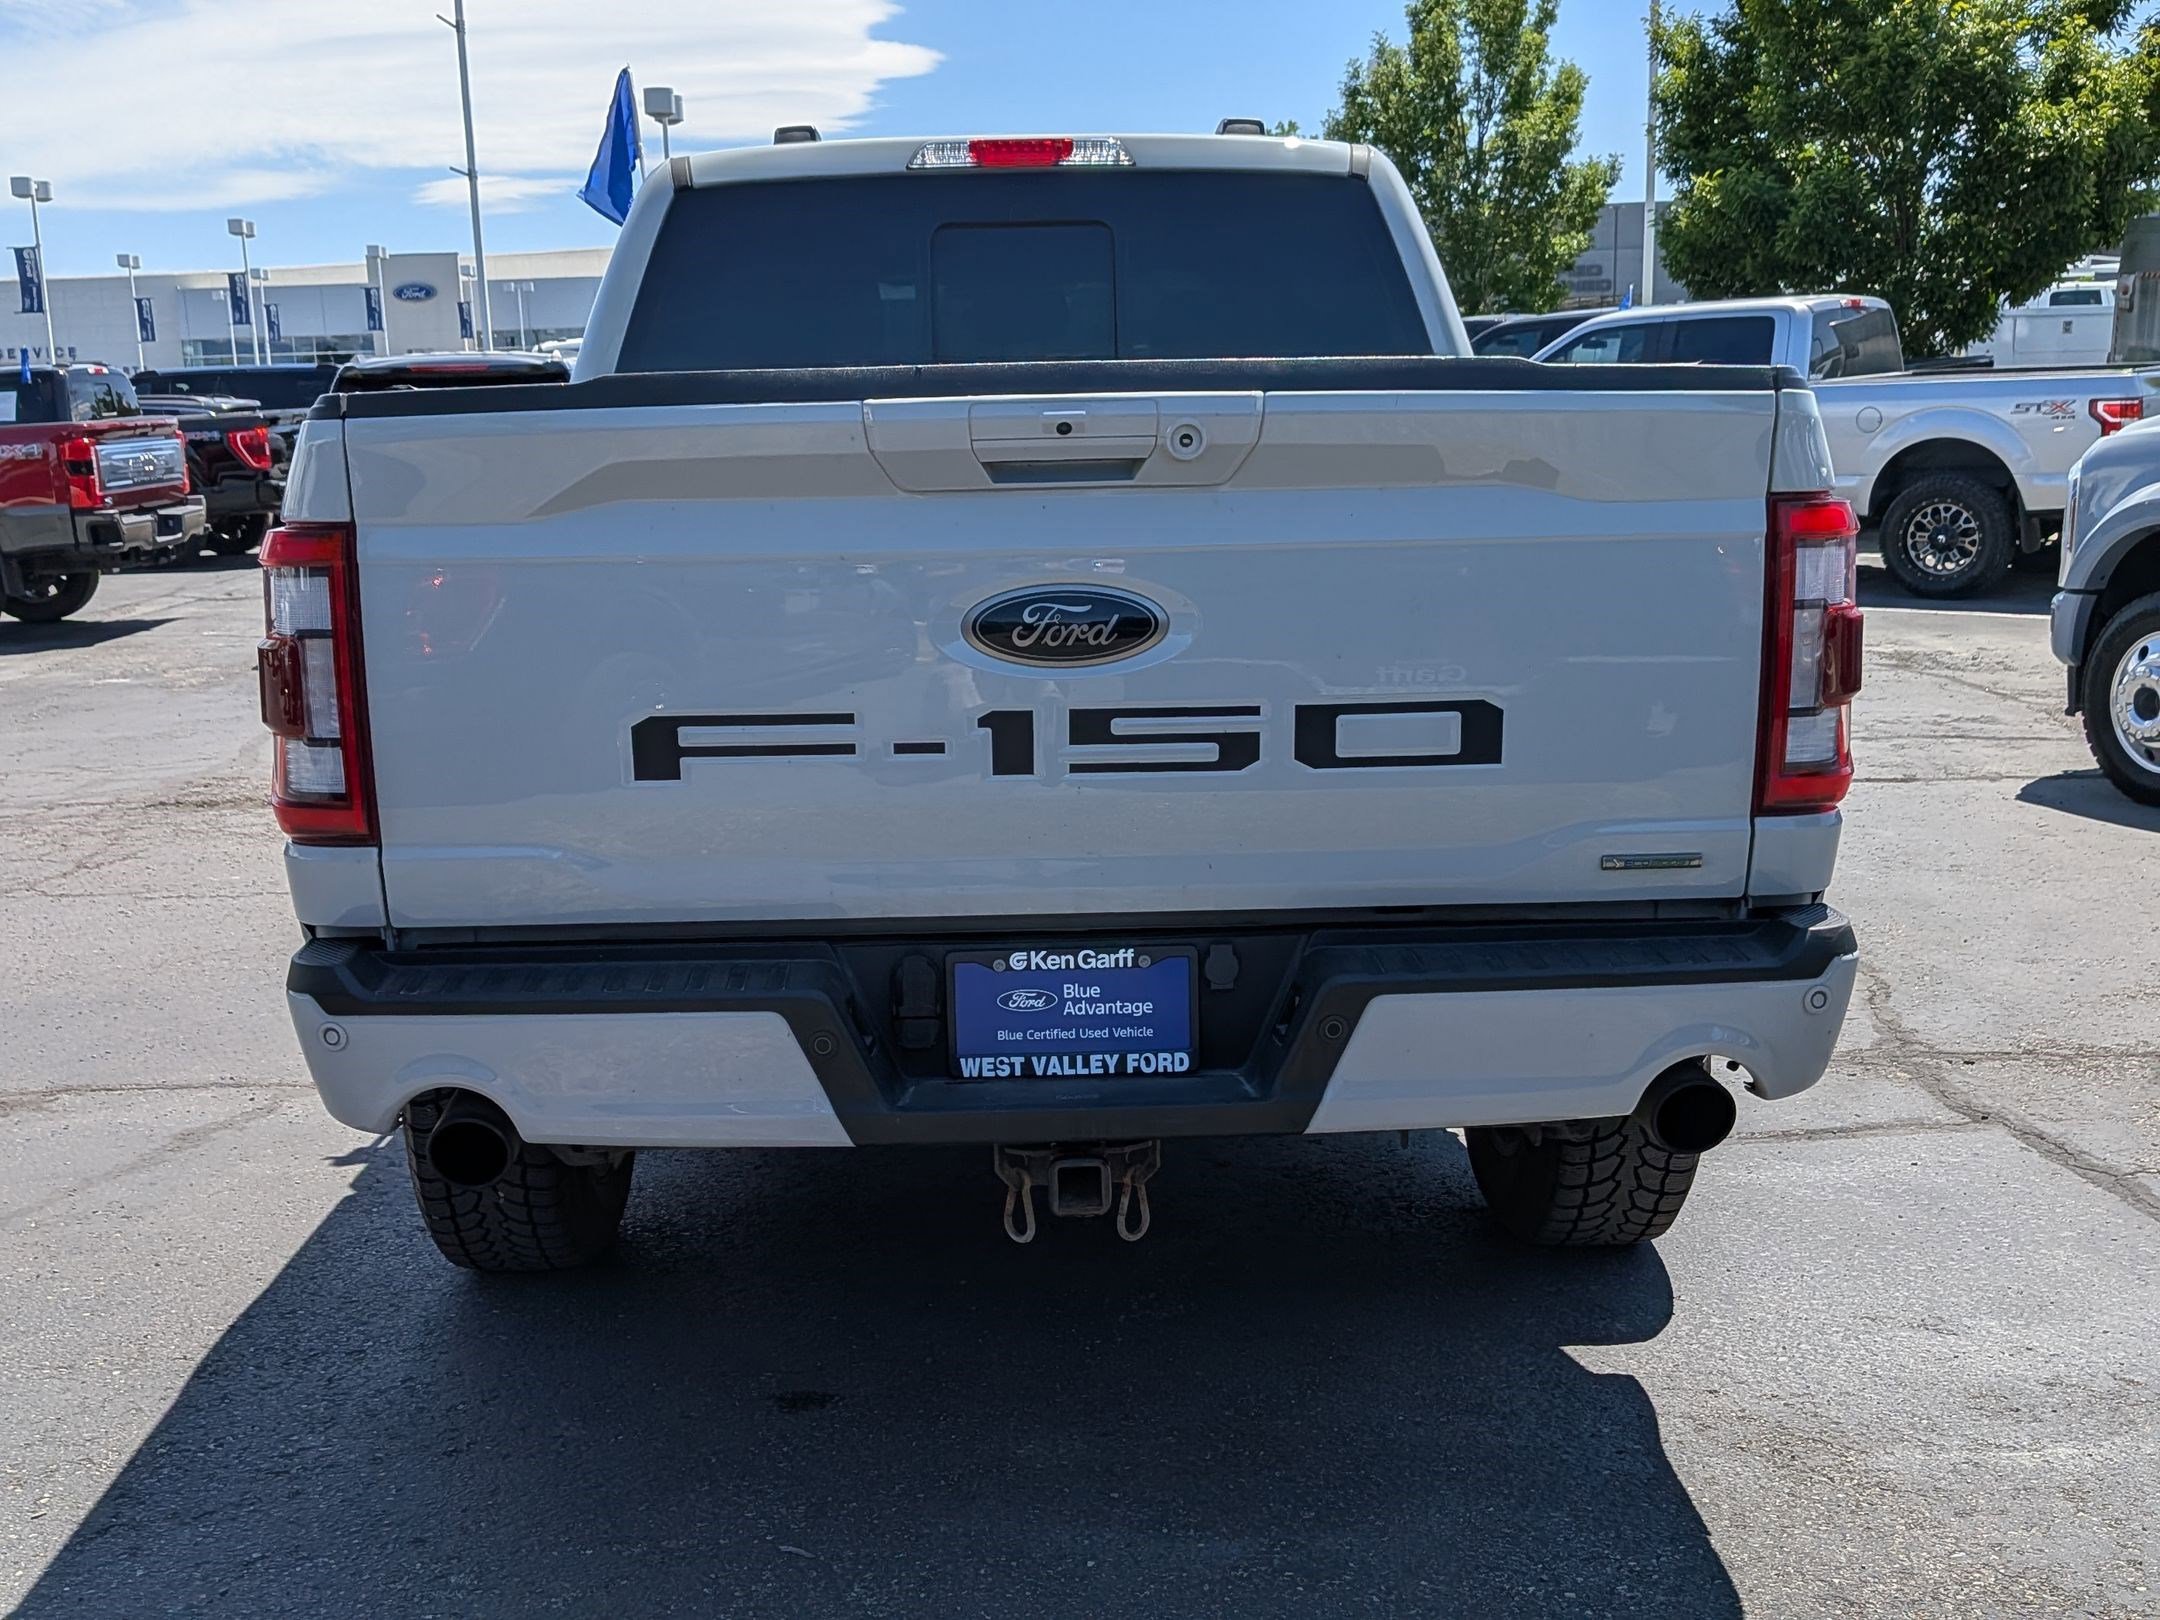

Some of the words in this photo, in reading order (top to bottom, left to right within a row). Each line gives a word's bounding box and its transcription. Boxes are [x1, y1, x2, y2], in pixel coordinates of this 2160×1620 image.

[2010, 399, 2077, 416] STX
[1011, 602, 1119, 647] Ford
[631, 699, 1504, 782] F-150
[1029, 950, 1075, 971] Ken
[1077, 948, 1135, 970] Garff
[1063, 983, 1101, 999] Blue
[1008, 992, 1046, 1008] Ford
[1063, 1000, 1154, 1017] Advantage
[997, 1030, 1024, 1041] Blue
[1026, 1028, 1076, 1040] Certified
[1079, 1027, 1109, 1039] Used
[1112, 1026, 1154, 1038] Vehicle
[959, 1056, 1025, 1078] WEST
[1031, 1053, 1120, 1076] VALLEY
[1126, 1052, 1190, 1074] FORD
